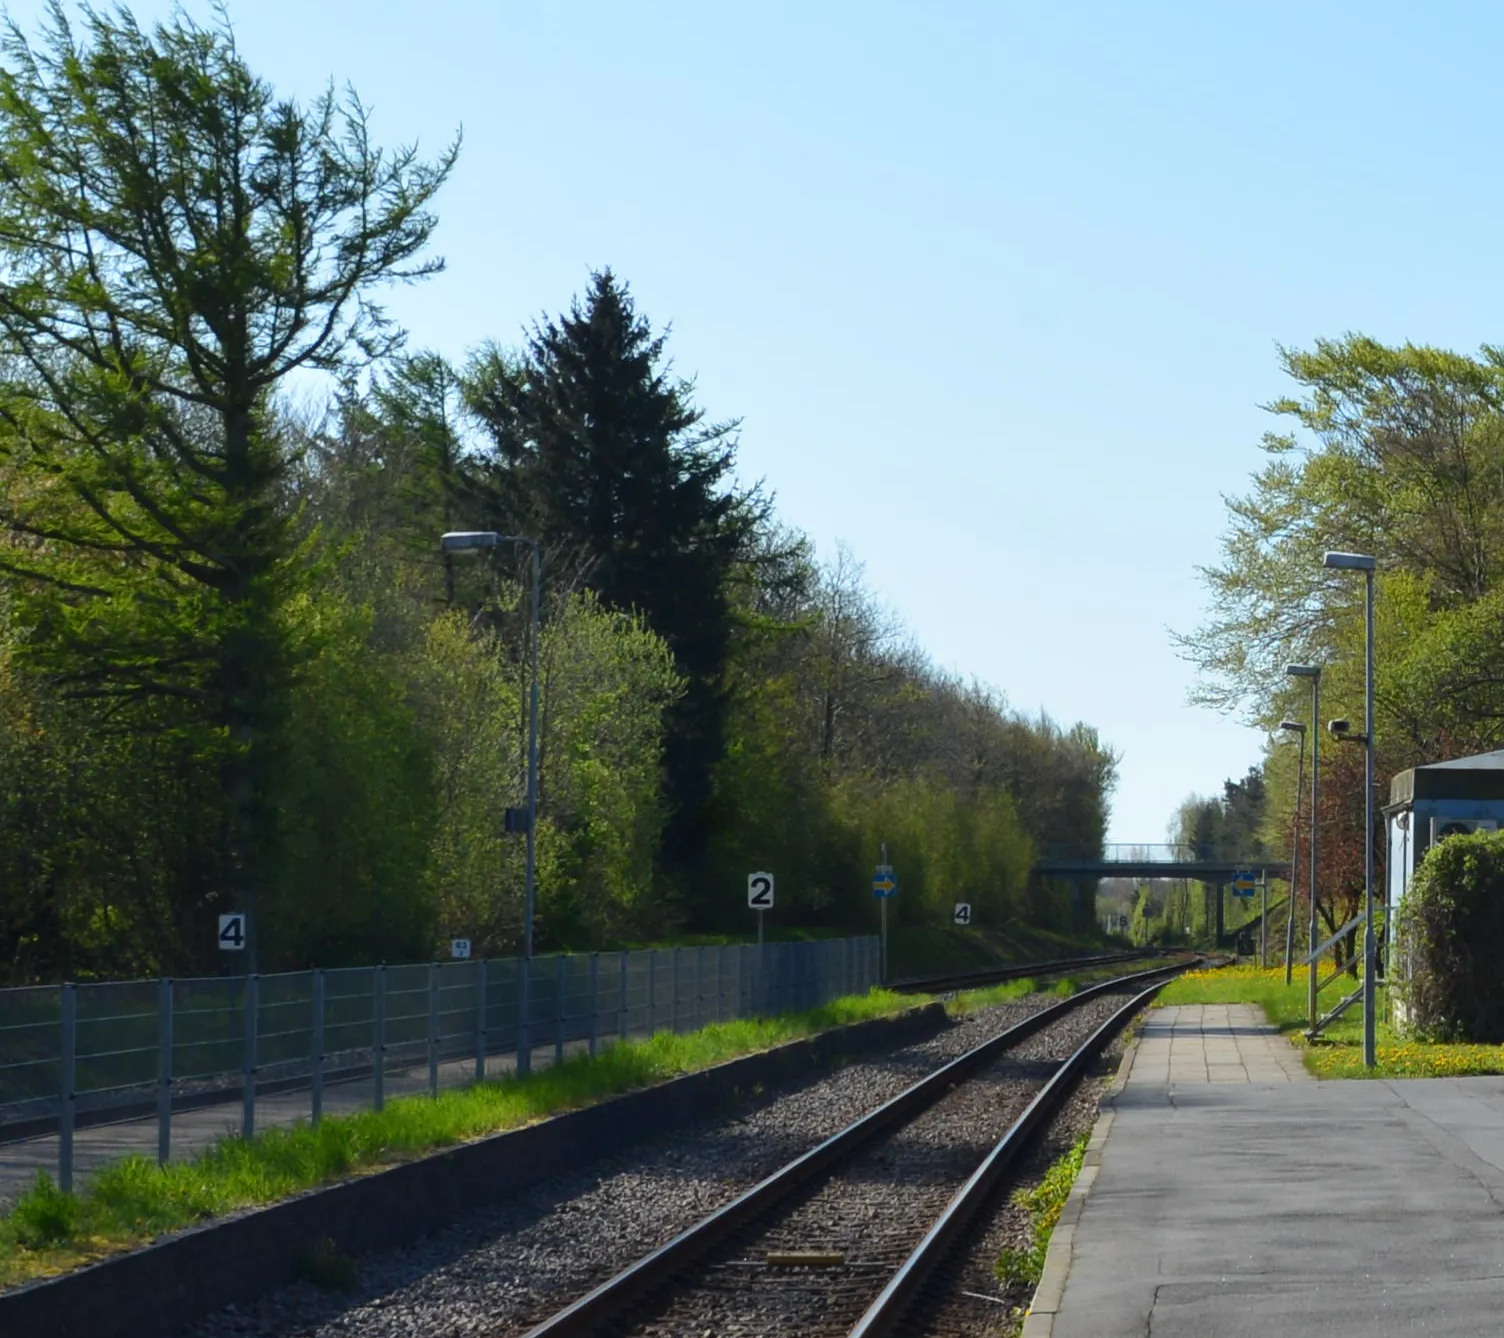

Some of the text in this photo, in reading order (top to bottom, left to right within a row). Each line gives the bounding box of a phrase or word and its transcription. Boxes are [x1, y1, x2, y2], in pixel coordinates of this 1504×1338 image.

[751, 876, 771, 905] 2
[956, 905, 969, 922] 4
[220, 917, 245, 947] 4
